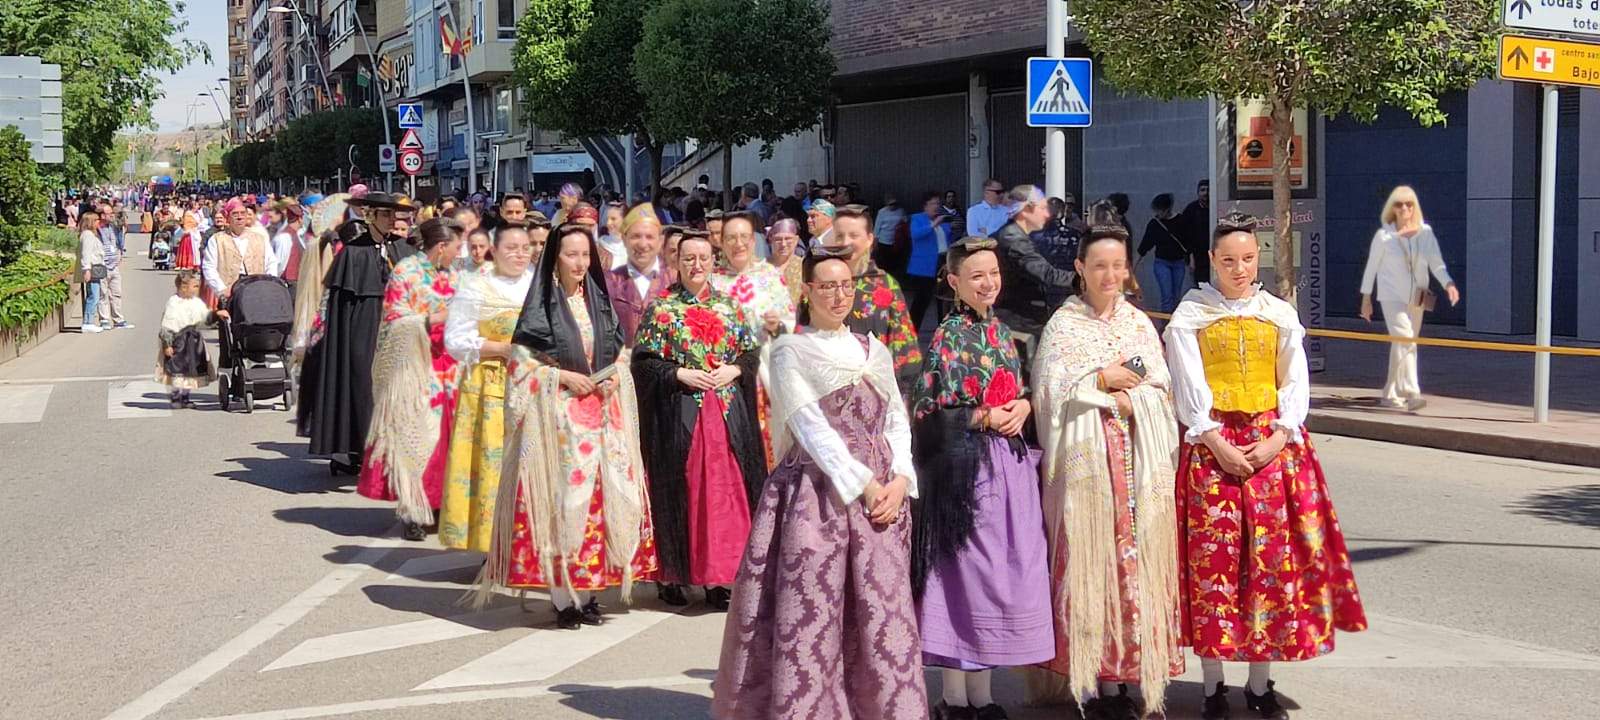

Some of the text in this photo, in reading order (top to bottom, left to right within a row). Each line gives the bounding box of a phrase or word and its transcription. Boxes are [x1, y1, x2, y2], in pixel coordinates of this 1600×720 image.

[1561, 49, 1585, 58] centro
[1572, 66, 1600, 81] Bajo
[405, 157, 420, 167] 20
[1310, 231, 1321, 353] BINVENIDOS
